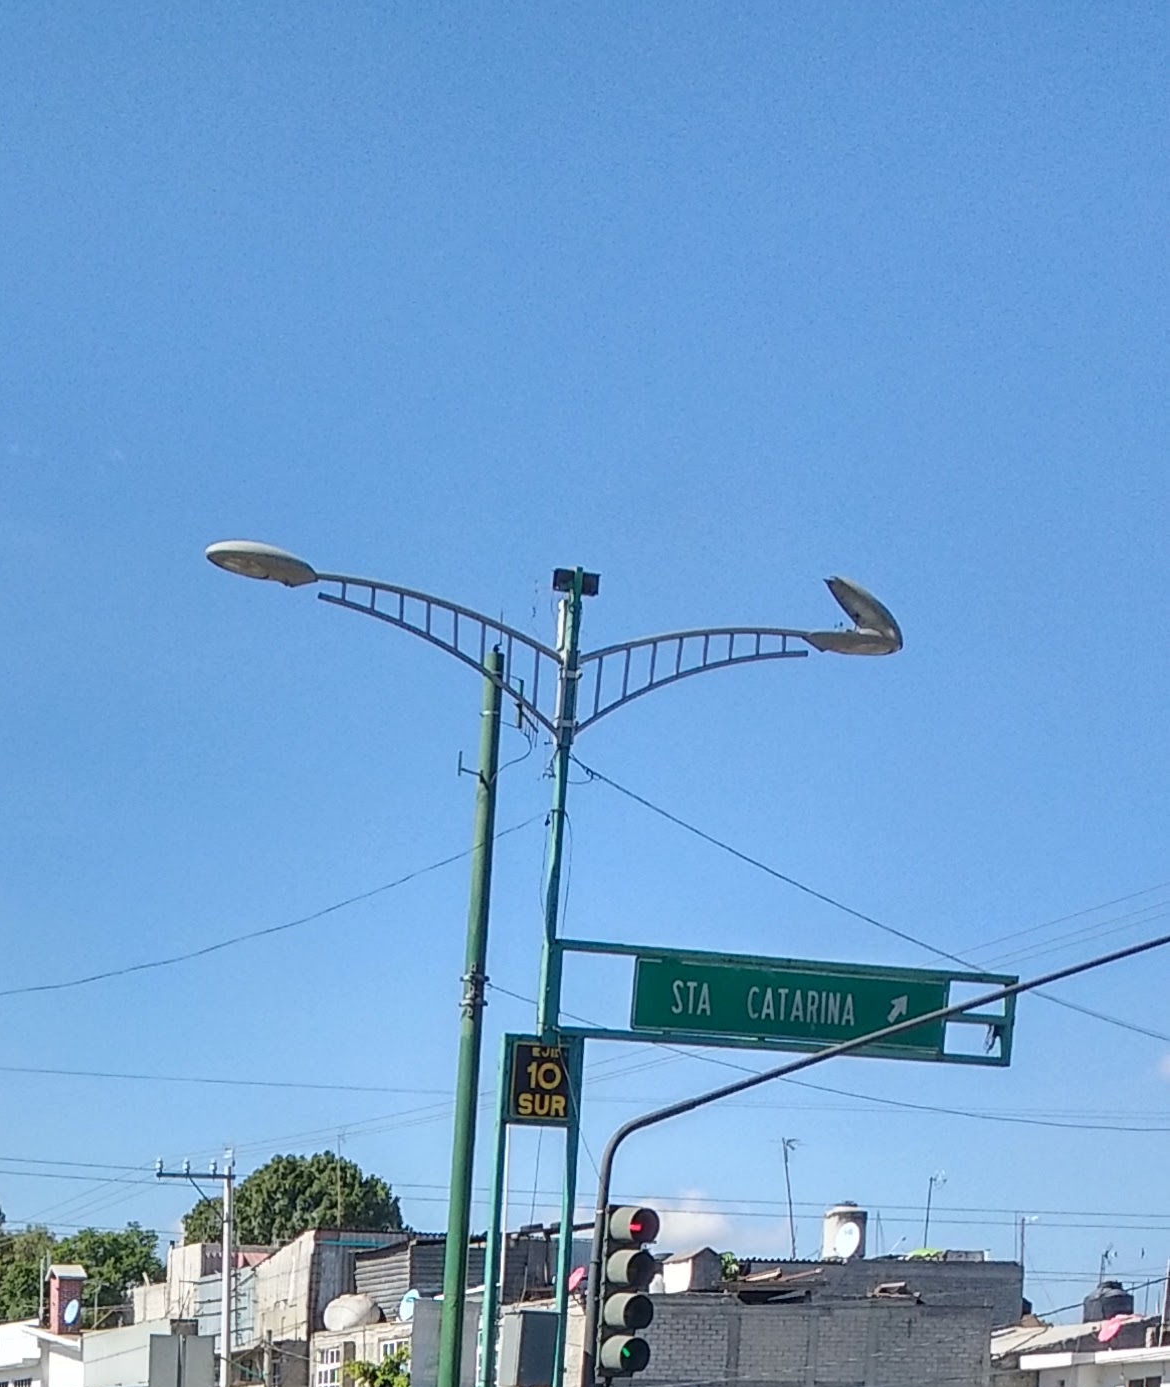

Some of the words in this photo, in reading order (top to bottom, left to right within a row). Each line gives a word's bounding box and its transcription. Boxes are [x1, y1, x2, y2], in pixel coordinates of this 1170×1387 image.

[670, 979, 711, 1016] STA
[747, 986, 855, 1027] CATARINA
[526, 1062, 562, 1090] 10
[517, 1092, 566, 1117] SUR
